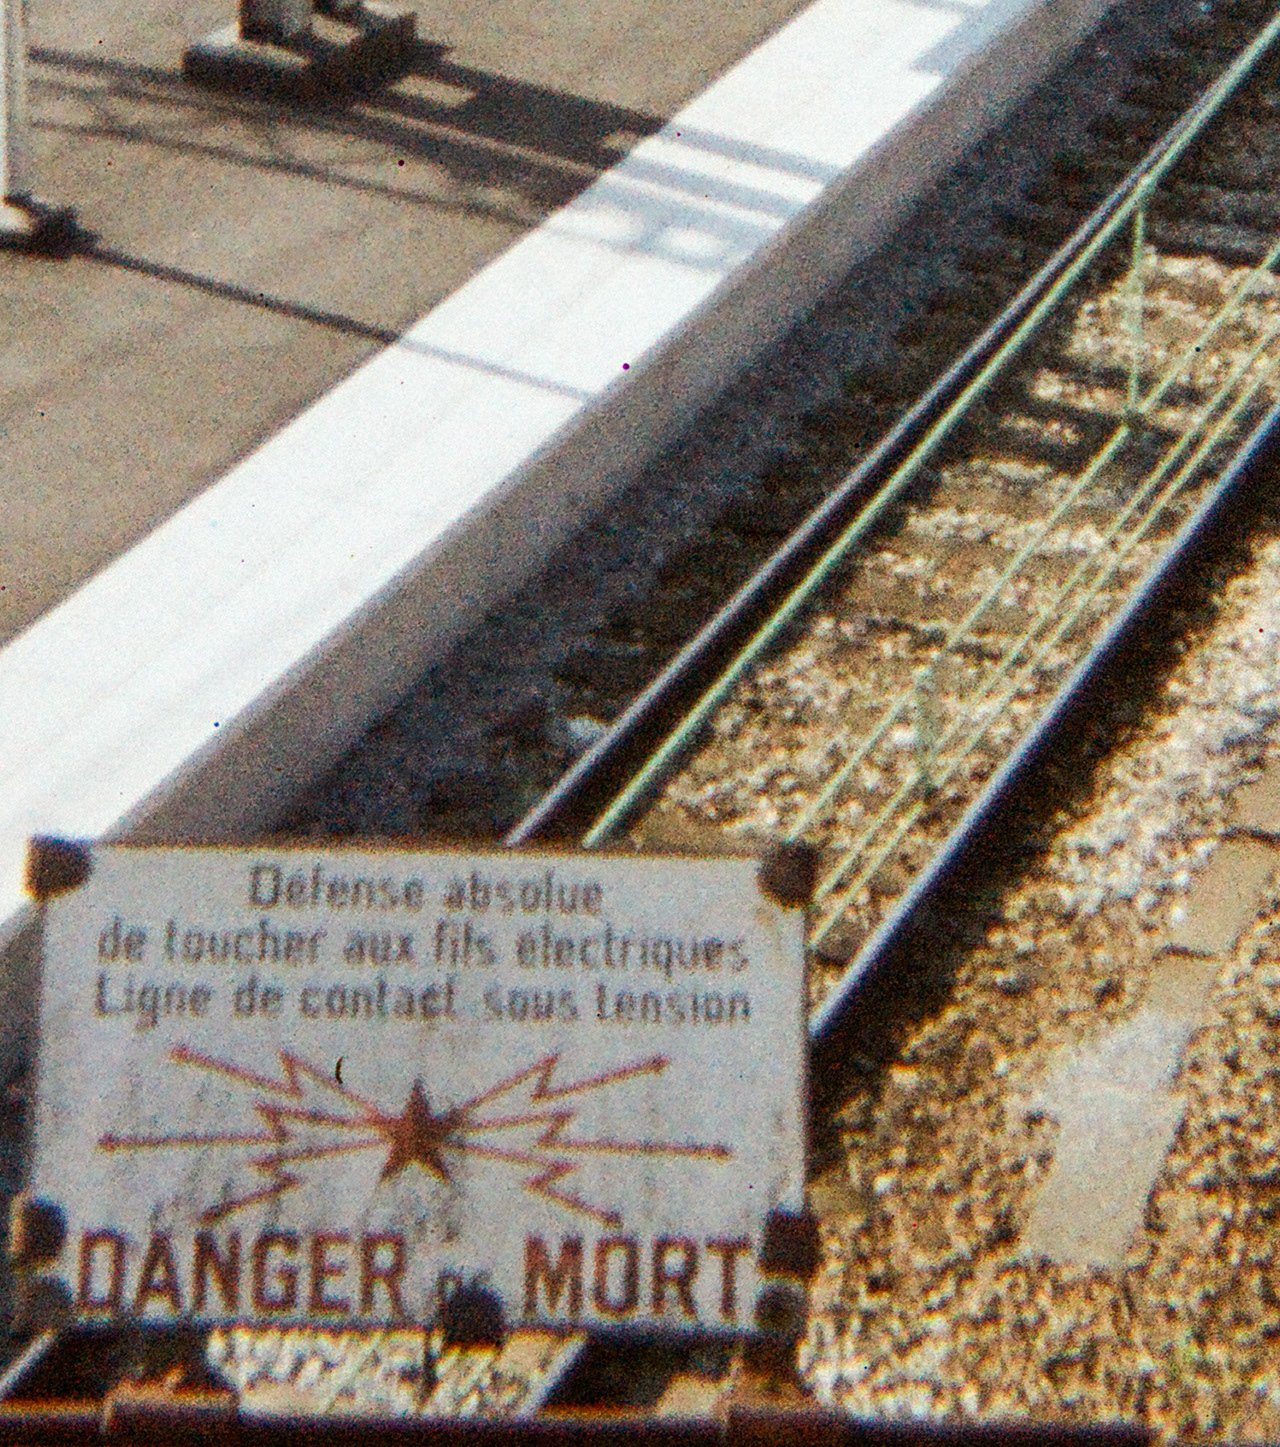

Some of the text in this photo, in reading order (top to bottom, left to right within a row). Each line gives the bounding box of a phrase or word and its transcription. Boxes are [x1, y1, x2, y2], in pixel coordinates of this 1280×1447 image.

[444, 867, 603, 916] absolue
[97, 916, 147, 963] de
[165, 918, 328, 966] toucher
[342, 927, 417, 966] aux
[434, 918, 496, 968] fils
[94, 971, 752, 1033] Ligne de contact sous tension
[76, 1227, 410, 1318] DANGER
[523, 1231, 754, 1325] MORT
